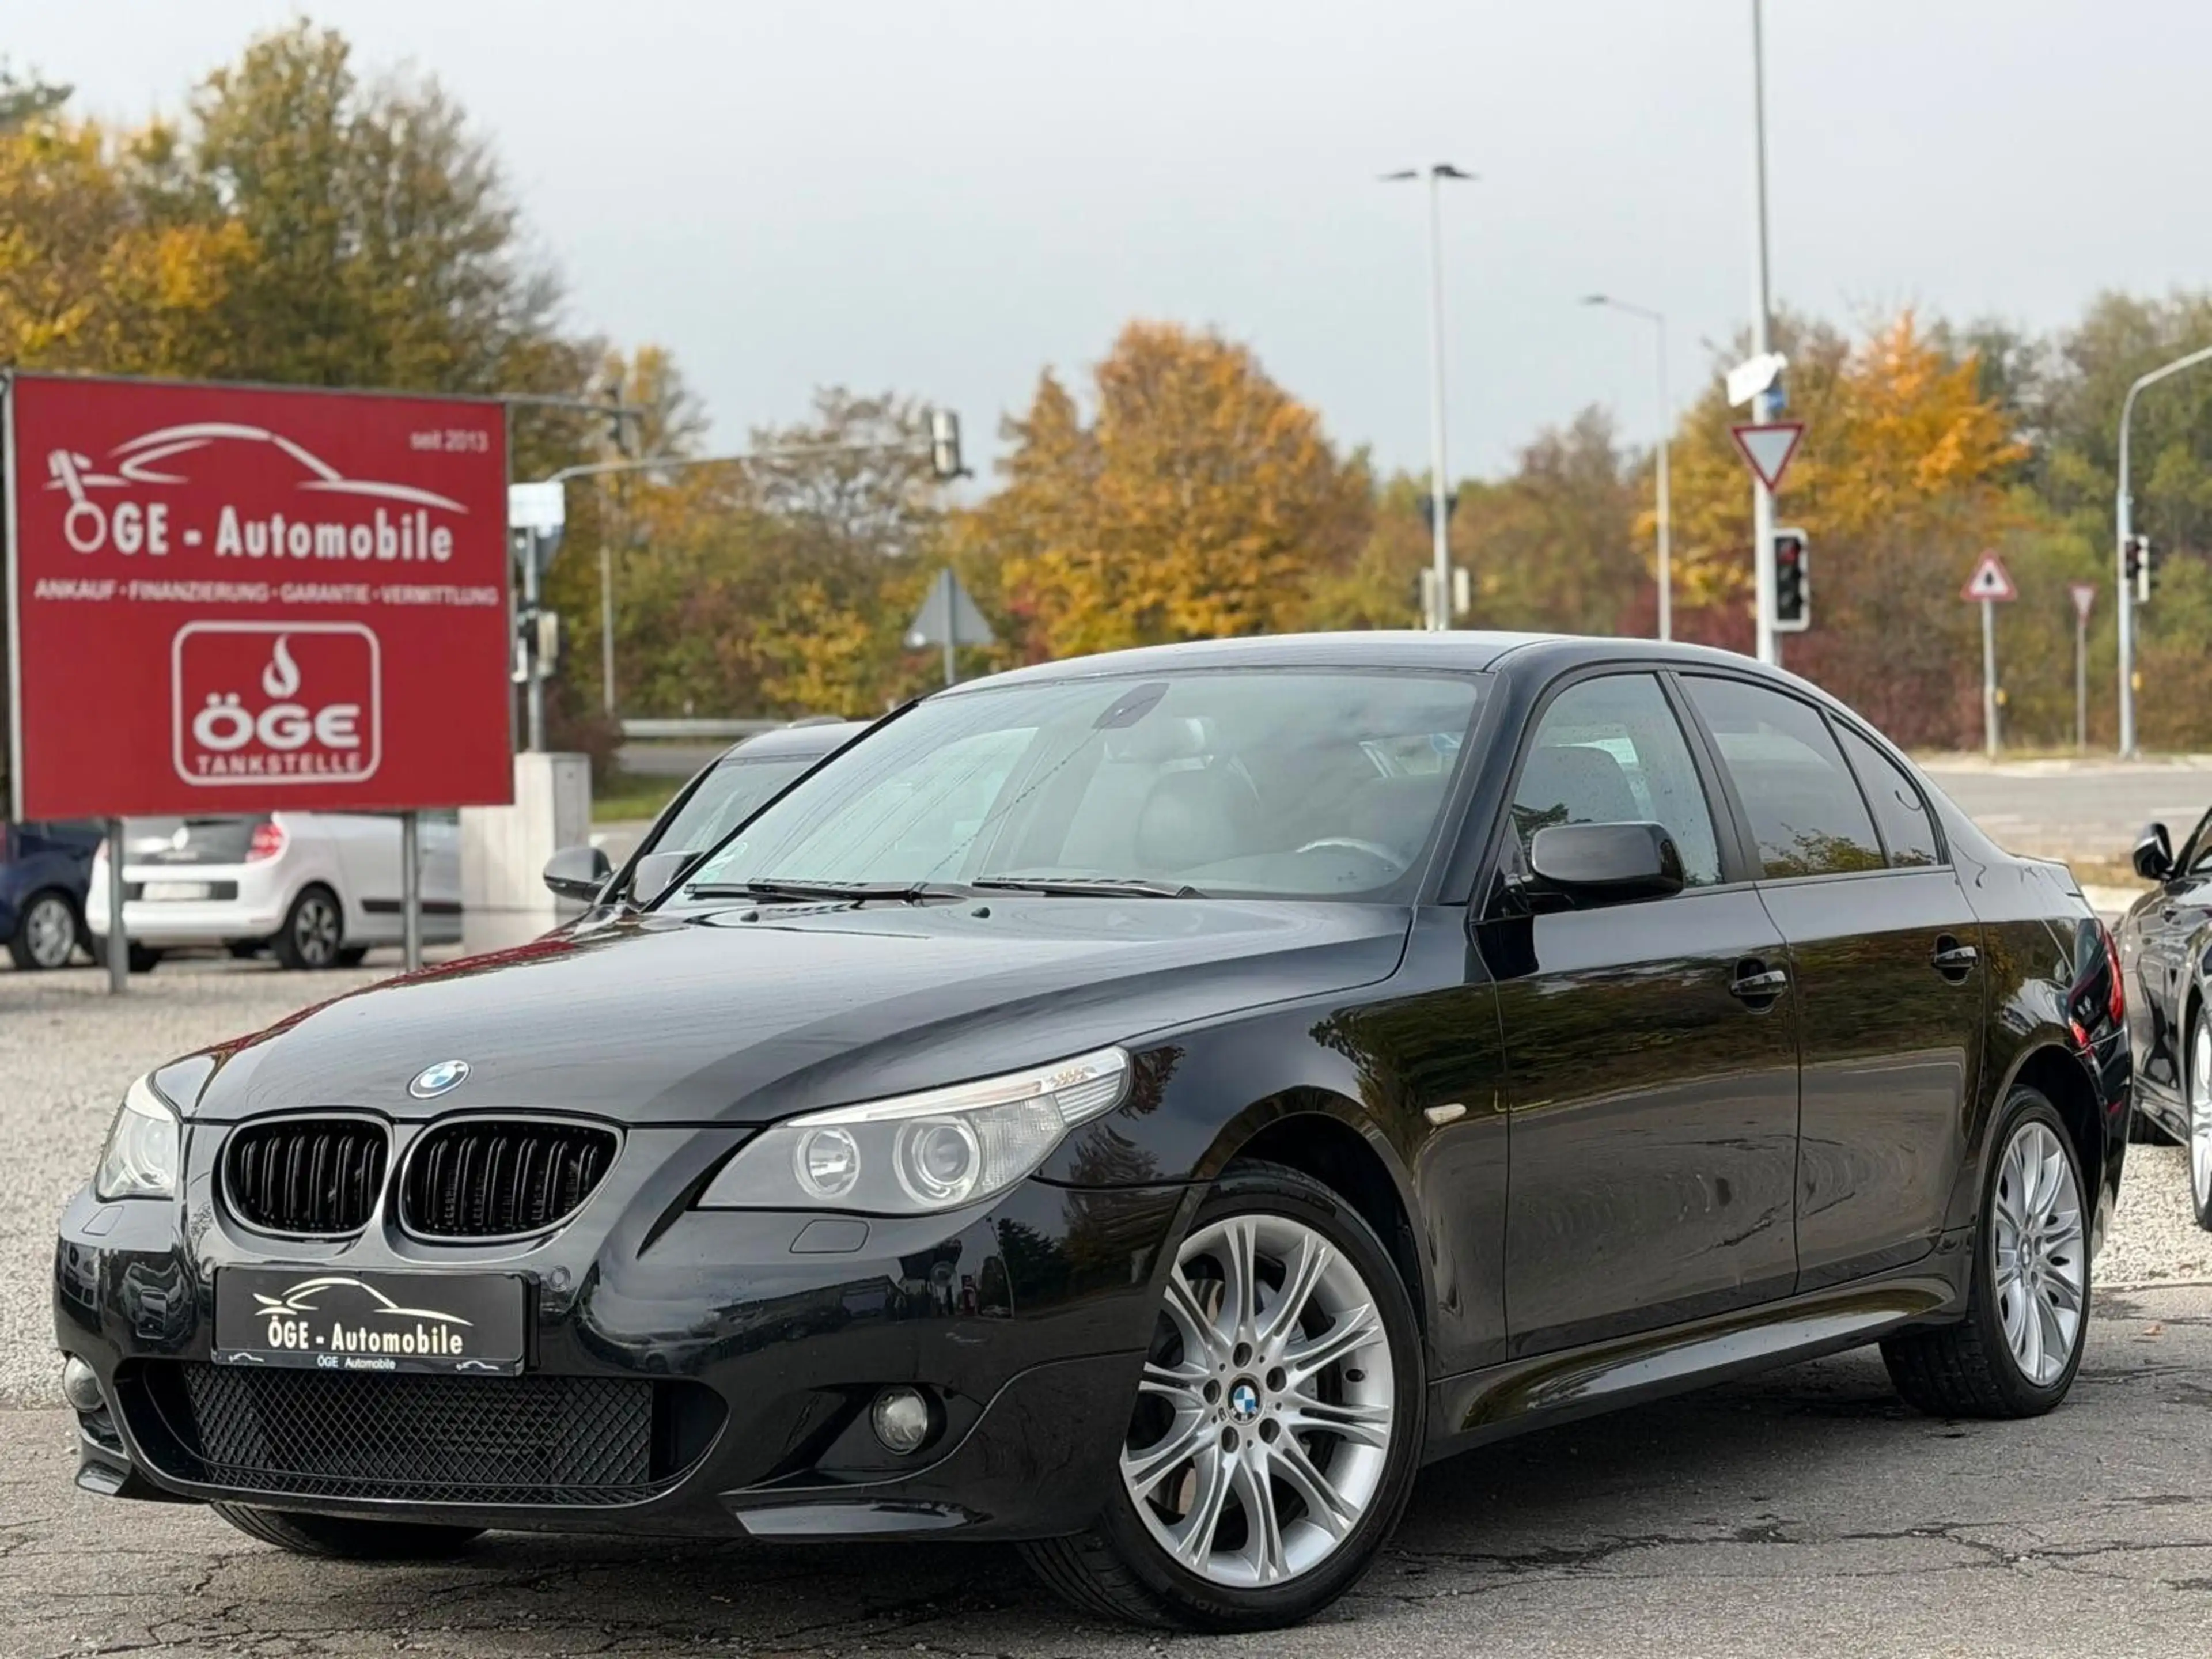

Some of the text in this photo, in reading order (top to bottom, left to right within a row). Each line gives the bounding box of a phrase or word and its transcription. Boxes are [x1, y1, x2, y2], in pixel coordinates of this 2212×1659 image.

[215, 504, 453, 561] Automobile
[33, 580, 499, 607] ANKAUF FINANZIERUNG GARANTIE VERMITTLUNG
[193, 693, 361, 750] ÖGE
[196, 753, 361, 775] TANKSTELLE
[331, 1323, 463, 1354] Automobile
[344, 1357, 396, 1370] Automobile
